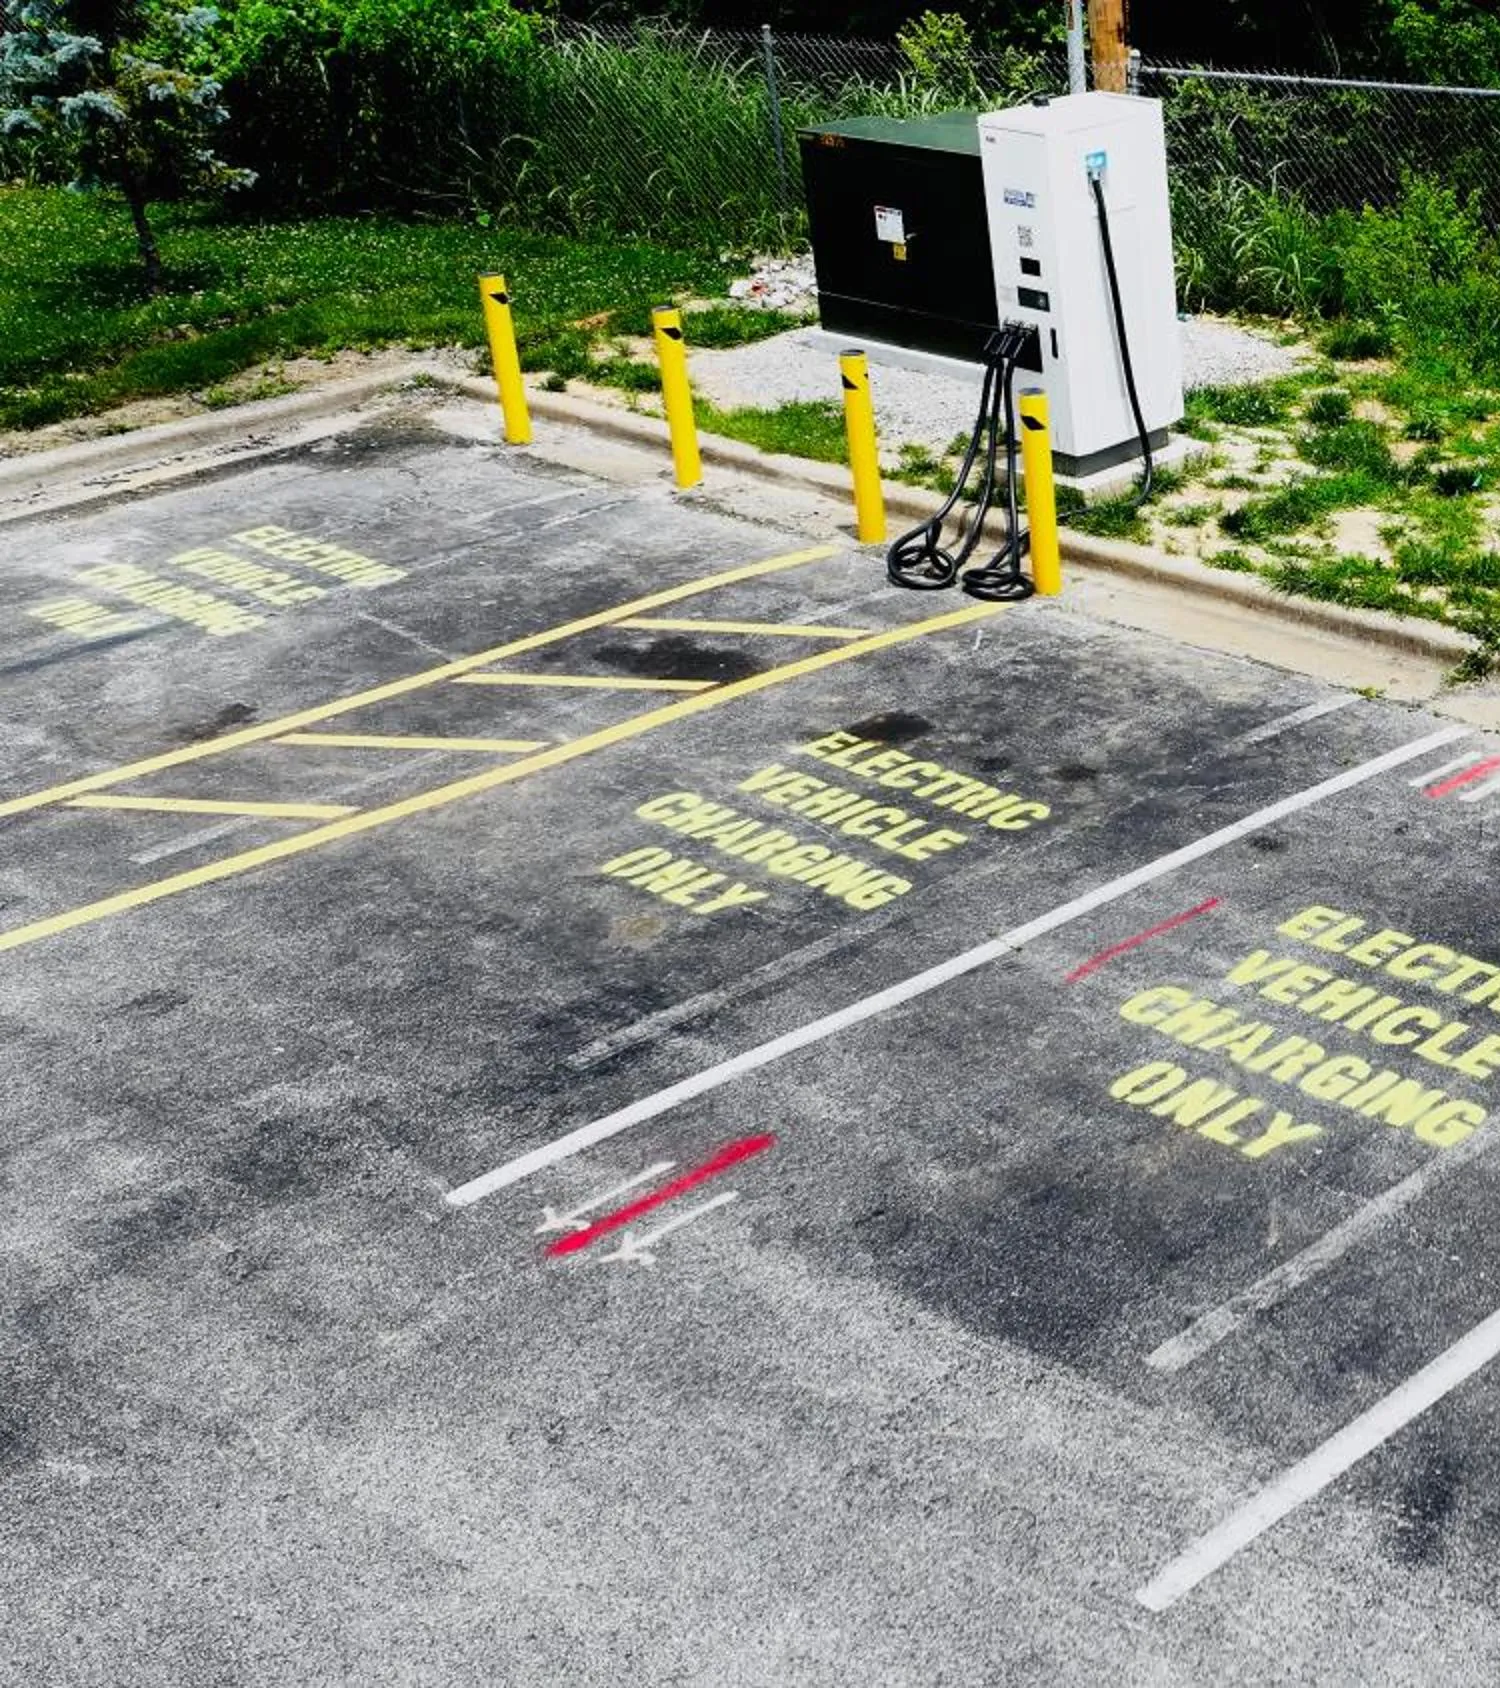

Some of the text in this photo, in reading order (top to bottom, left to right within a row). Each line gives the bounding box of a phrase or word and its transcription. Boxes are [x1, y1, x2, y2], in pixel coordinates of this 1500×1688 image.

[736, 763, 970, 861] VEHICLE
[800, 731, 1051, 830] ELECTRIC
[600, 847, 769, 914] ONLY
[635, 791, 913, 911] CHARGING
[1108, 1061, 1322, 1158] ONLY
[1118, 985, 1488, 1148] CHARGING
